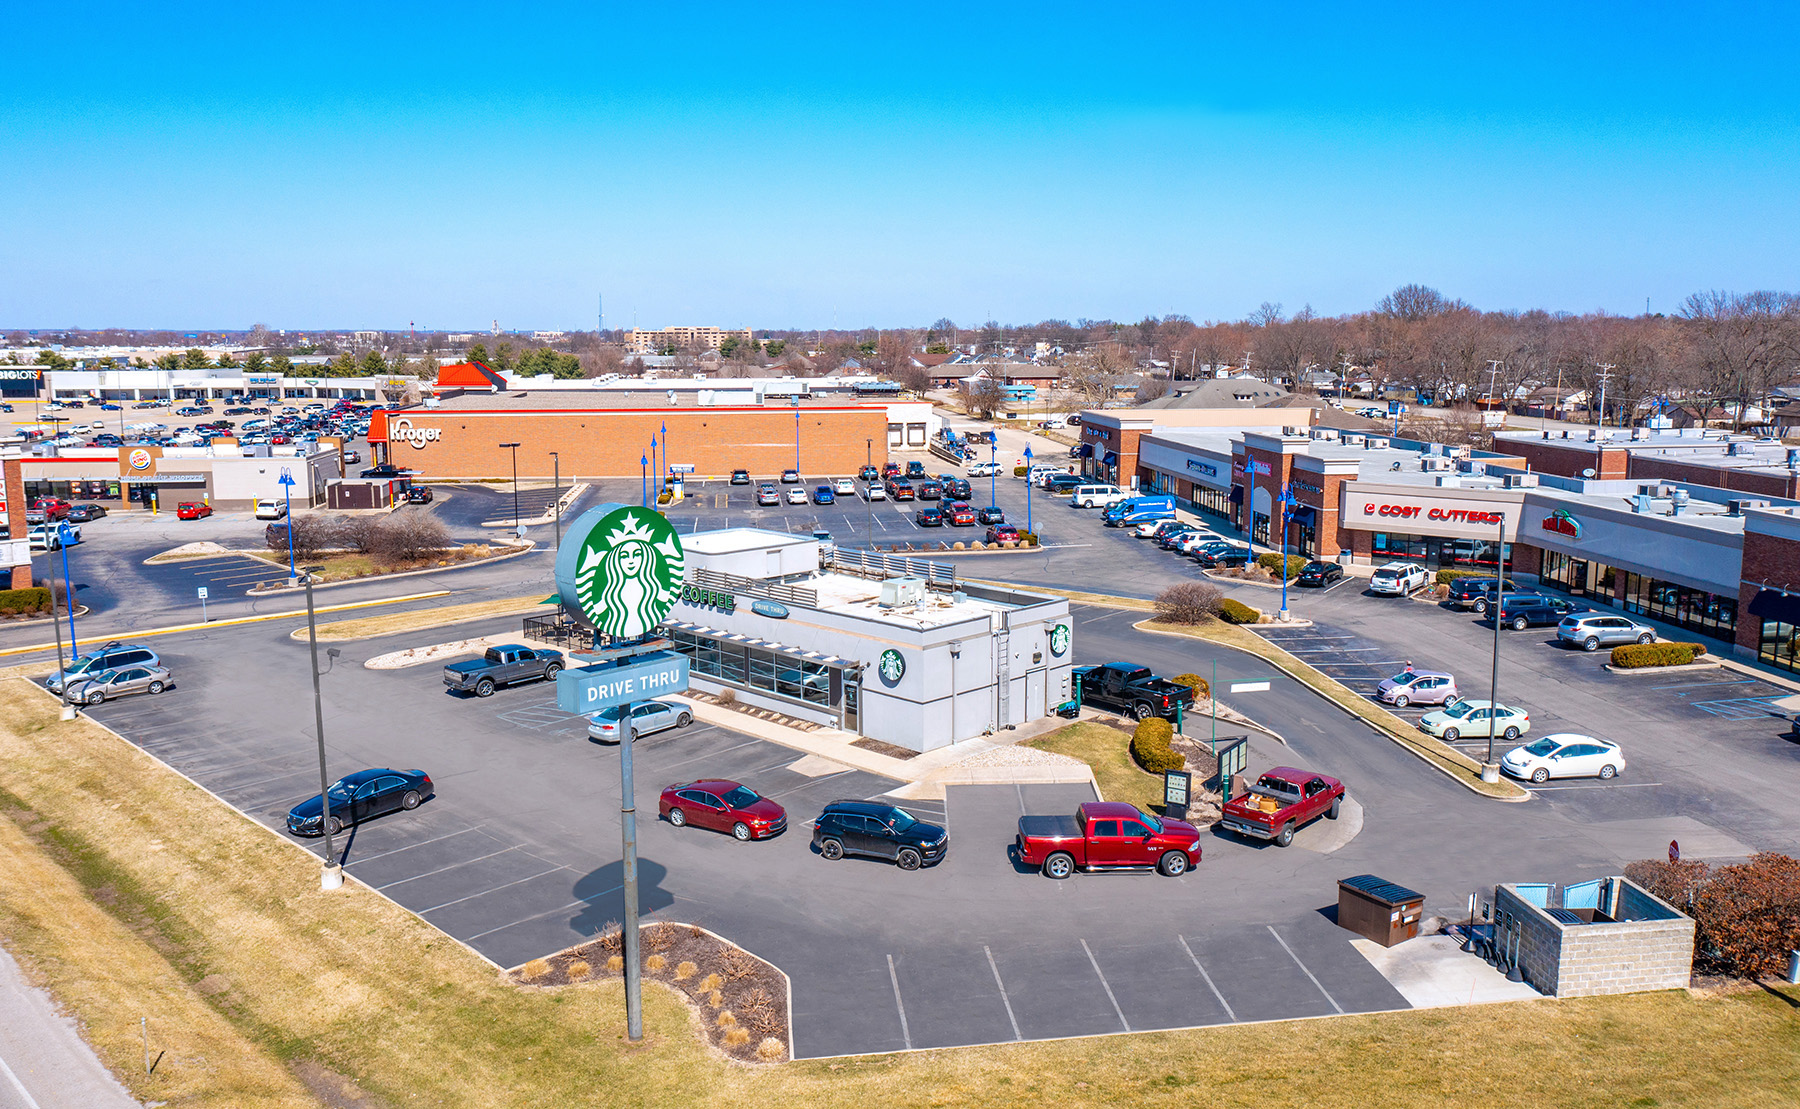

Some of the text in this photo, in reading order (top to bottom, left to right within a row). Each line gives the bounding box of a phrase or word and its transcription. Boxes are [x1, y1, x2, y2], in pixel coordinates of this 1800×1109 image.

[390, 418, 442, 449] Kroger
[133, 456, 148, 465] KING
[1379, 504, 1422, 517] COST
[1429, 508, 1501, 523] CUTTERS
[682, 585, 734, 610] COFFEE
[755, 603, 785, 615] DRIVE THRU
[587, 669, 680, 702] DRIVE THRU
